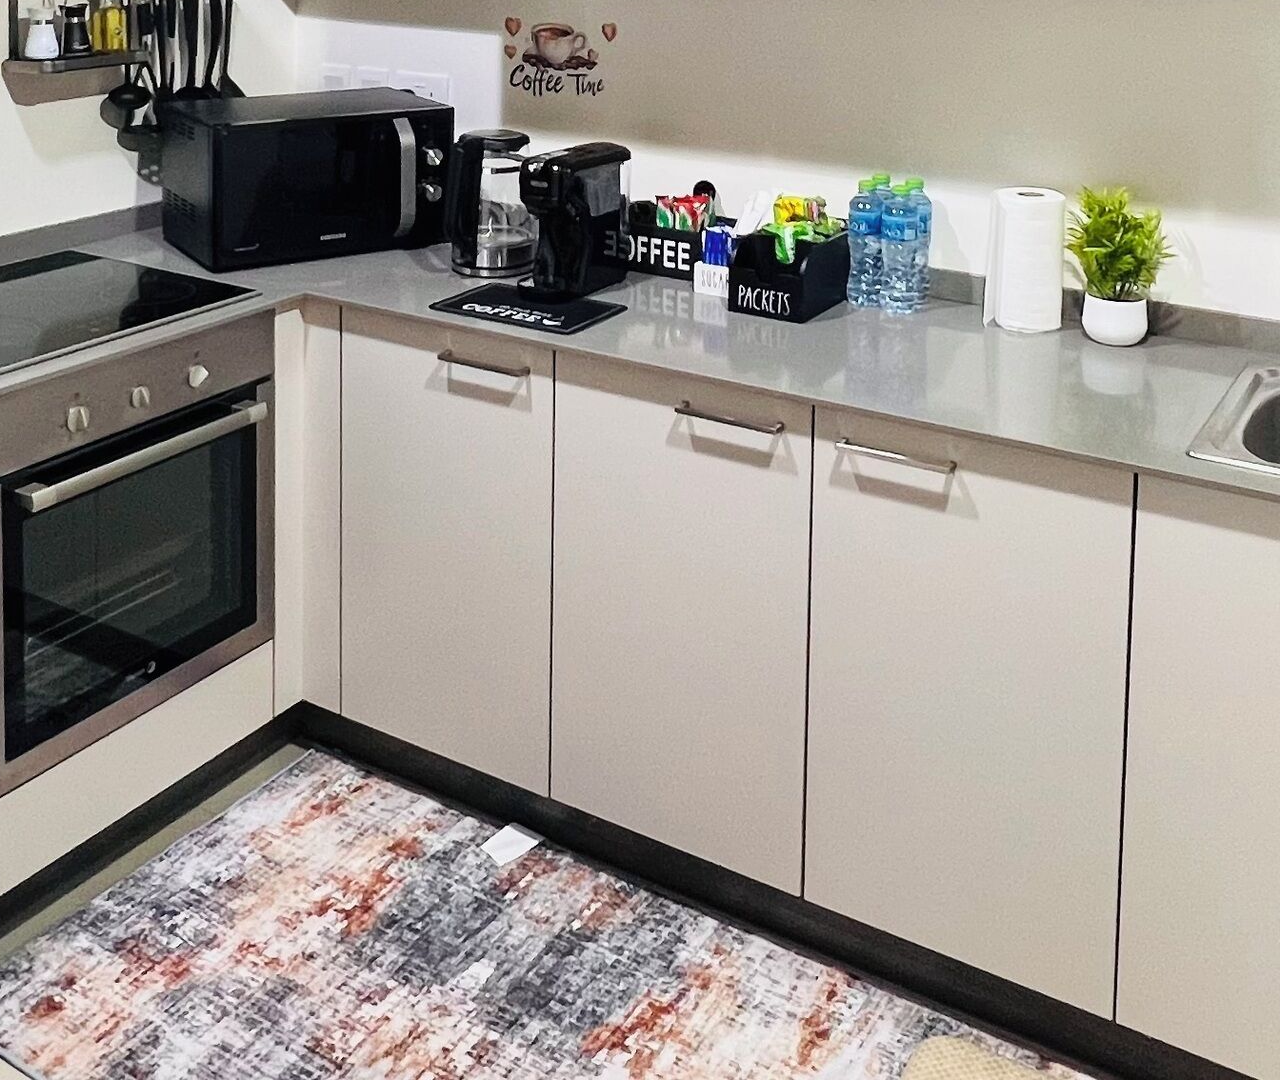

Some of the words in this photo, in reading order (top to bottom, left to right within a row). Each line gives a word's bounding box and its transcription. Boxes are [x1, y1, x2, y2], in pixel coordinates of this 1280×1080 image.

[509, 64, 565, 96] Coffee
[628, 234, 691, 271] OFFEE
[461, 303, 542, 323] COFFEE
[738, 284, 790, 316] PACKETS
